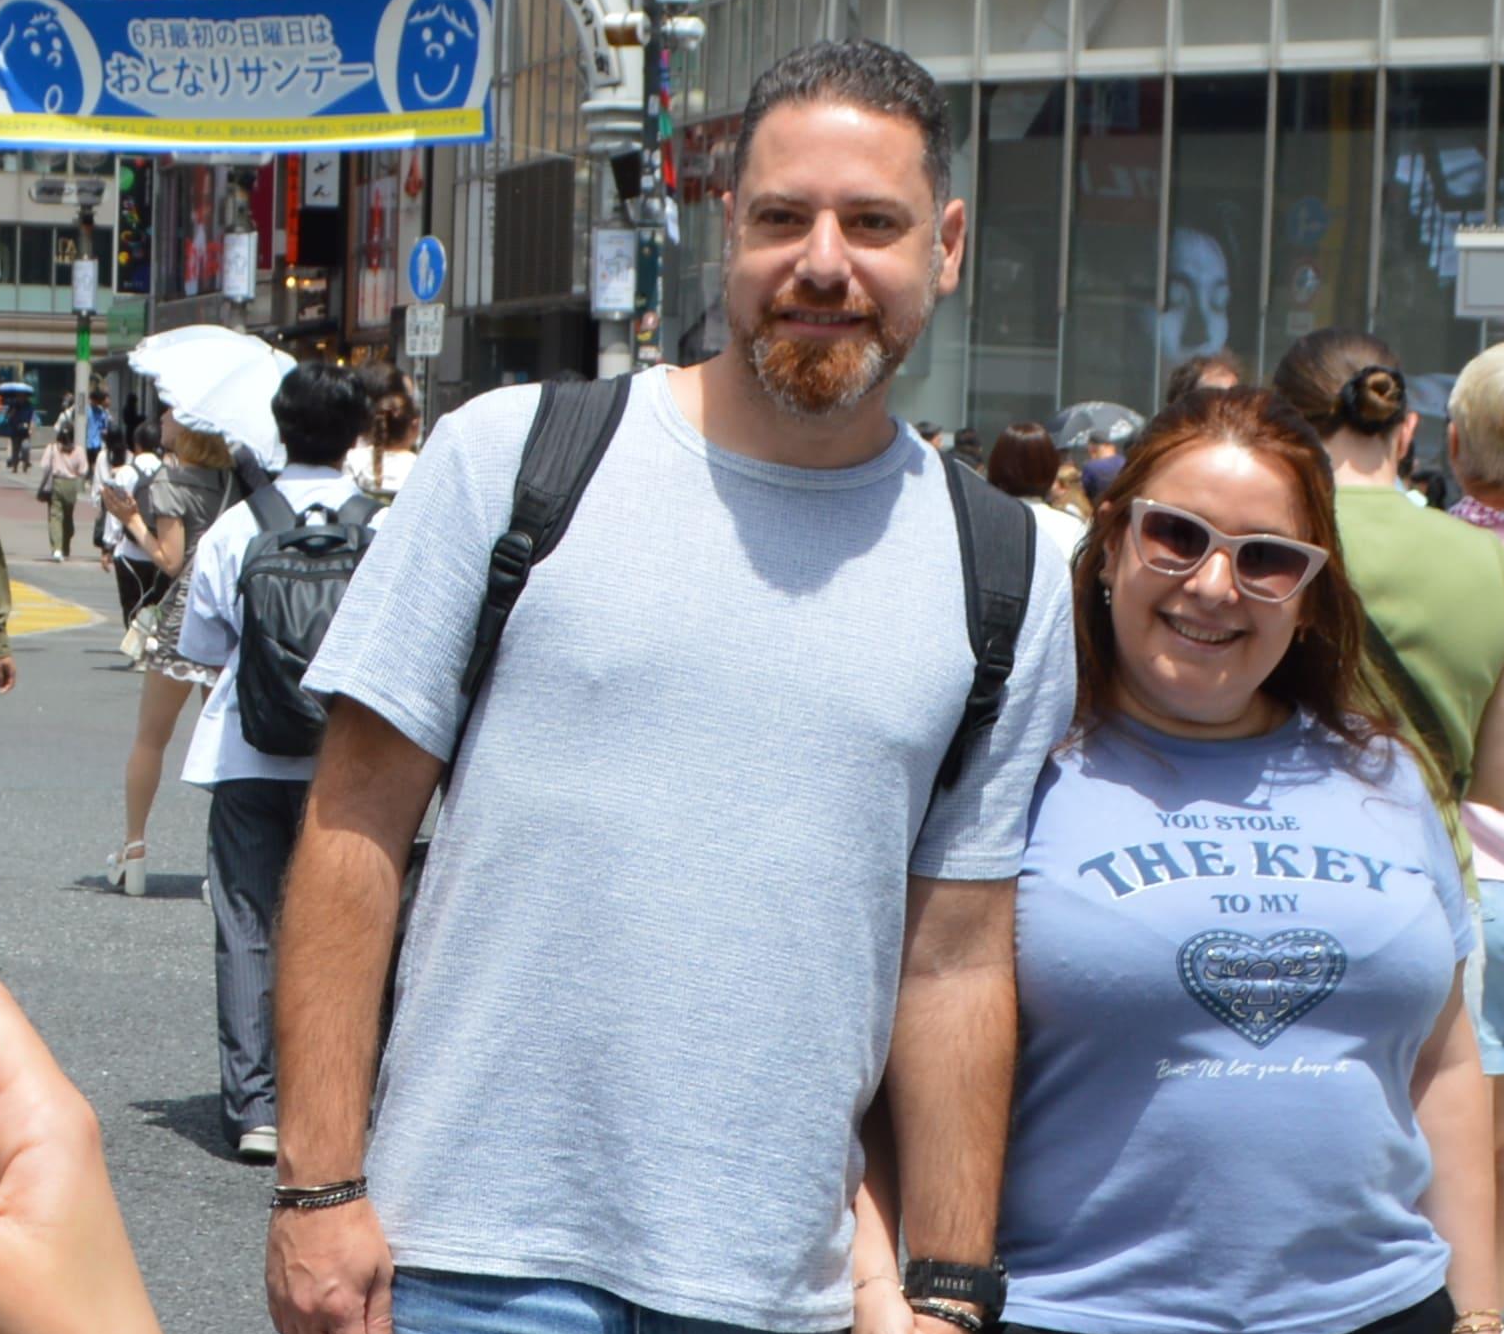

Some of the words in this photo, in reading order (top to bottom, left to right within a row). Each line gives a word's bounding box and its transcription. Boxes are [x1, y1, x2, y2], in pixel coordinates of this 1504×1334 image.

[131, 16, 331, 50] 6月最初の日曜日は
[109, 51, 372, 97] おとなりサンデー
[1155, 812, 1209, 830] YOU
[1214, 815, 1300, 832] STOLE
[1078, 840, 1235, 899] THE
[1252, 840, 1392, 892] KEY
[1210, 894, 1251, 914] TO
[1259, 894, 1299, 914] MY
[1155, 1058, 1195, 1080] But
[1226, 1058, 1256, 1076] let
[1256, 1064, 1289, 1080] you
